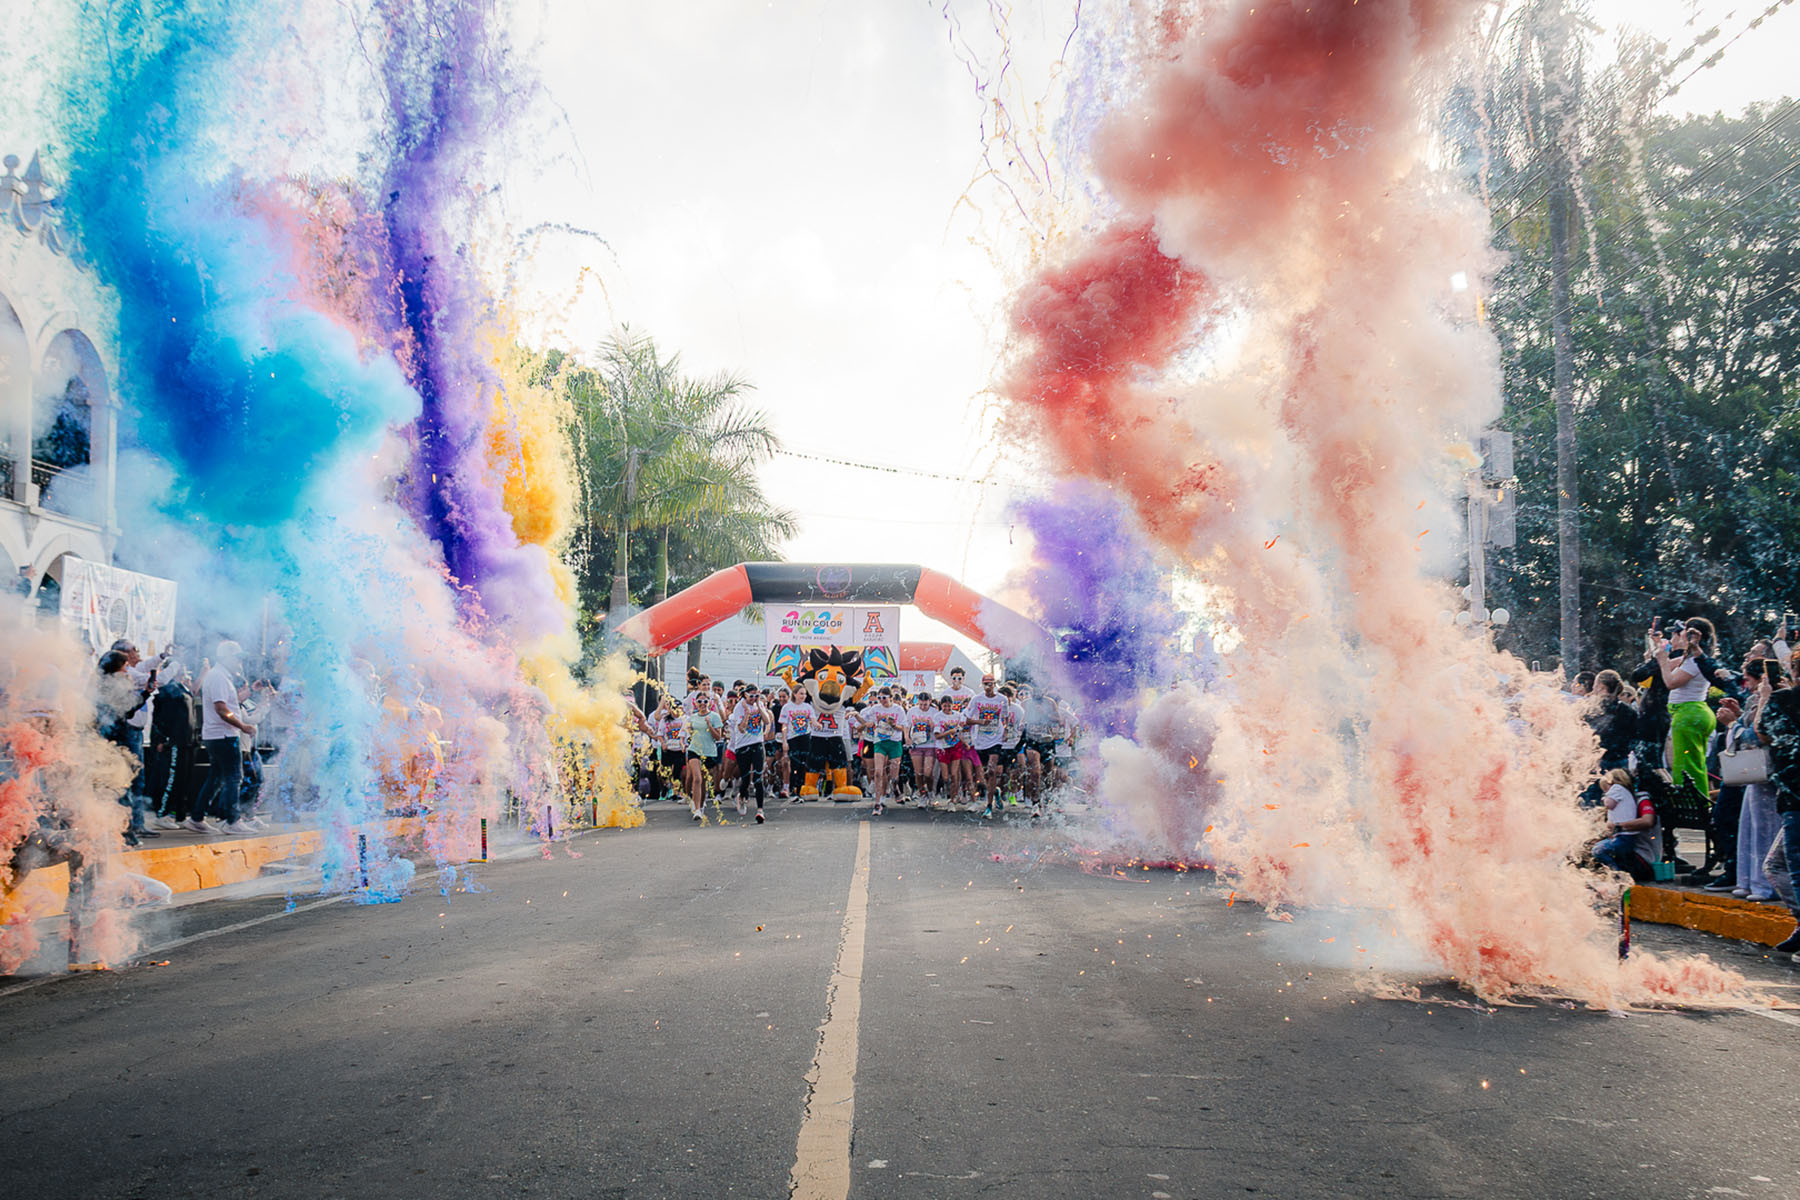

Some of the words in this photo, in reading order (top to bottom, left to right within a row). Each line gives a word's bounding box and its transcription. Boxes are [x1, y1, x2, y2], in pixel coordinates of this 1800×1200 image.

[781, 611, 843, 634] 2026
[813, 620, 842, 628] COLOR
[863, 612, 884, 632] A
